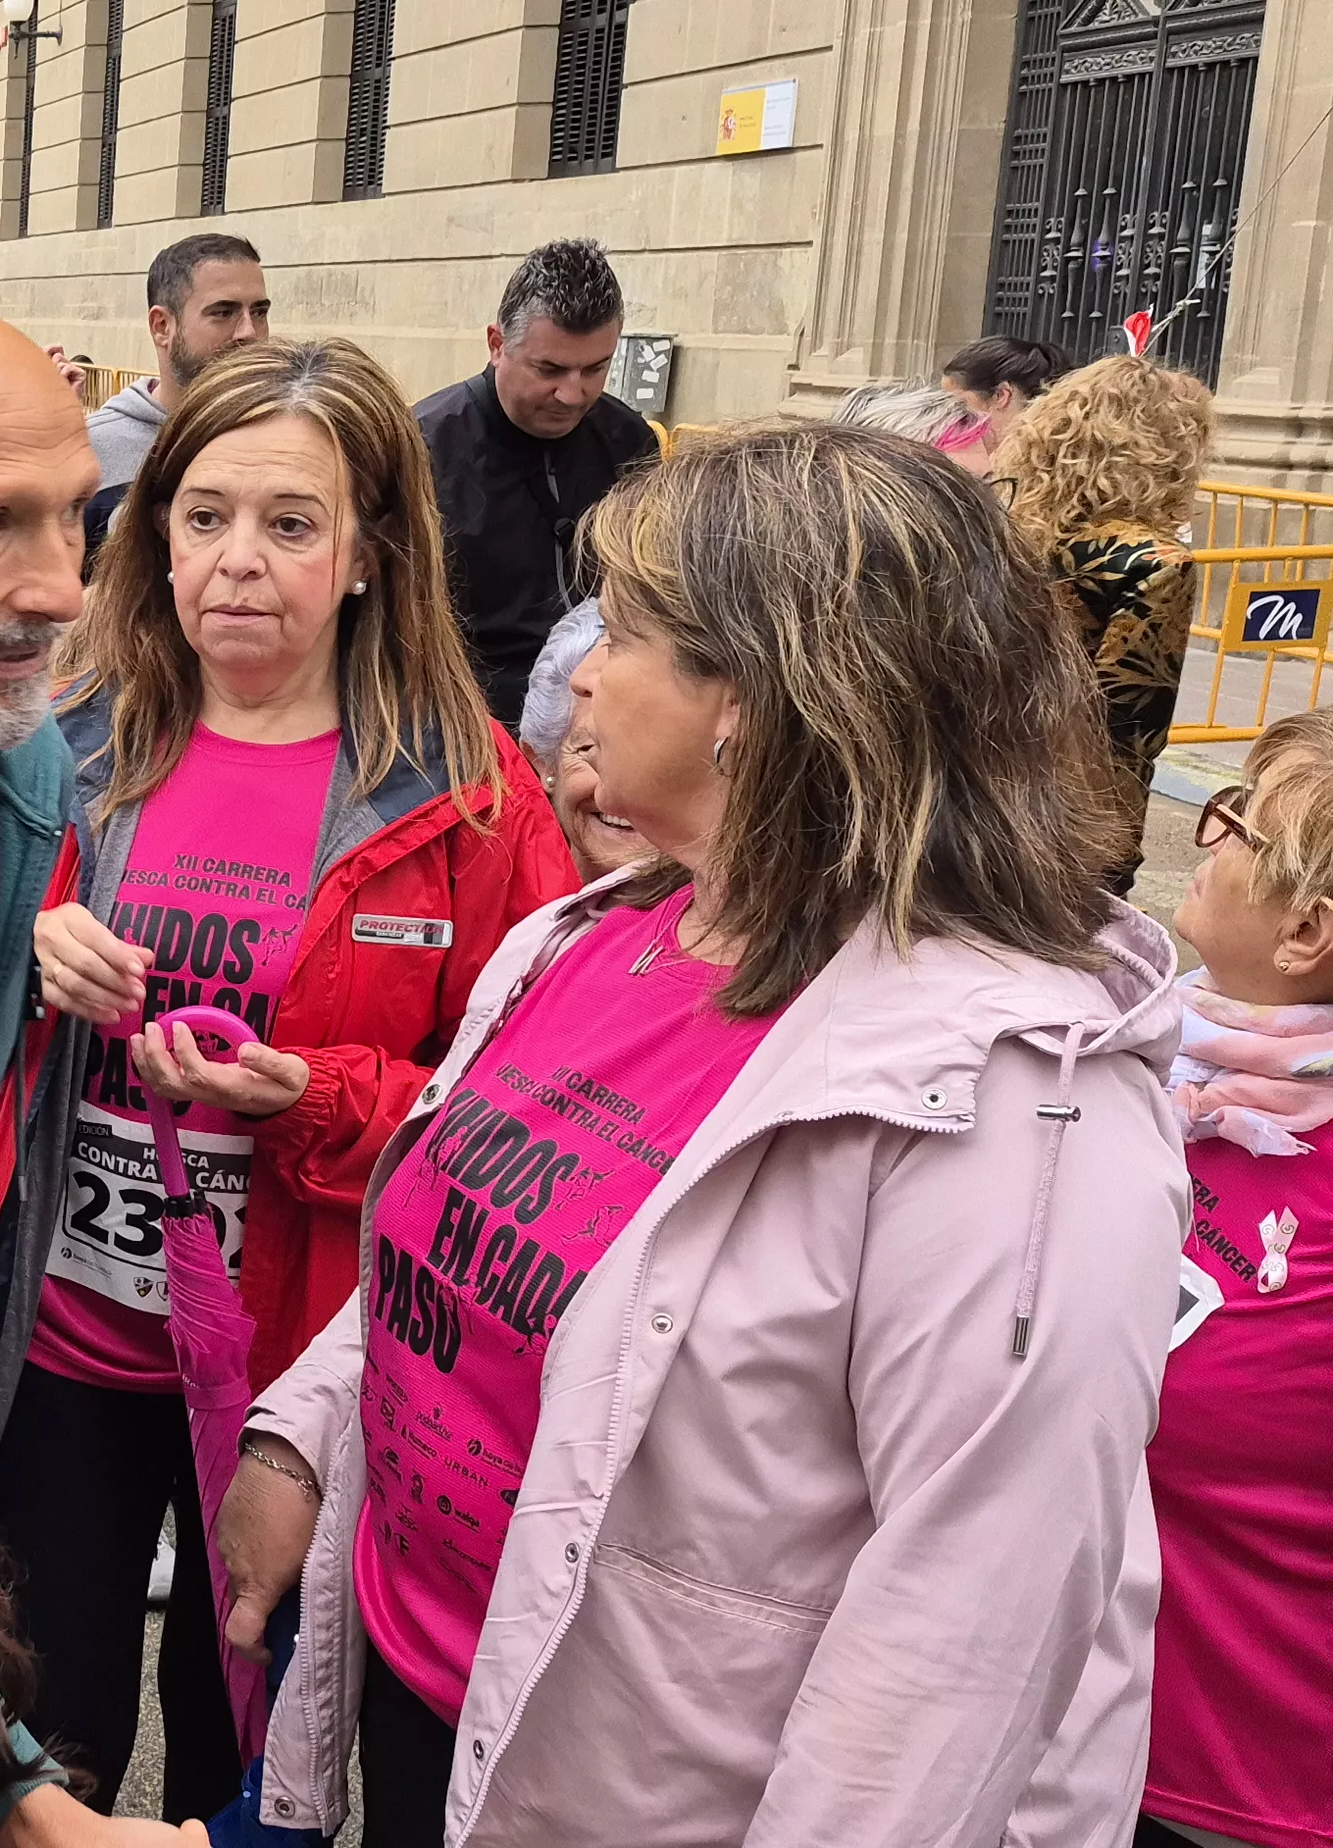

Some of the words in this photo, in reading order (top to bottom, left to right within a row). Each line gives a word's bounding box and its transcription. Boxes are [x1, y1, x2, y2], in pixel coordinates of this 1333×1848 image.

[173, 874, 251, 901] CONTRA
[255, 887, 278, 906] EL
[174, 854, 199, 871] XII
[202, 857, 293, 888] CARRERA
[109, 901, 262, 985] NIDOS
[532, 1080, 603, 1135] CONTRA
[599, 1117, 625, 1142] EL
[566, 1070, 648, 1125] CARRERA
[77, 1141, 159, 1181] CONTRA
[426, 1185, 491, 1288] EN
[1196, 1220, 1258, 1283] CÁNCER
[375, 1231, 463, 1375] PASO
[444, 1457, 489, 1488] URBAN
